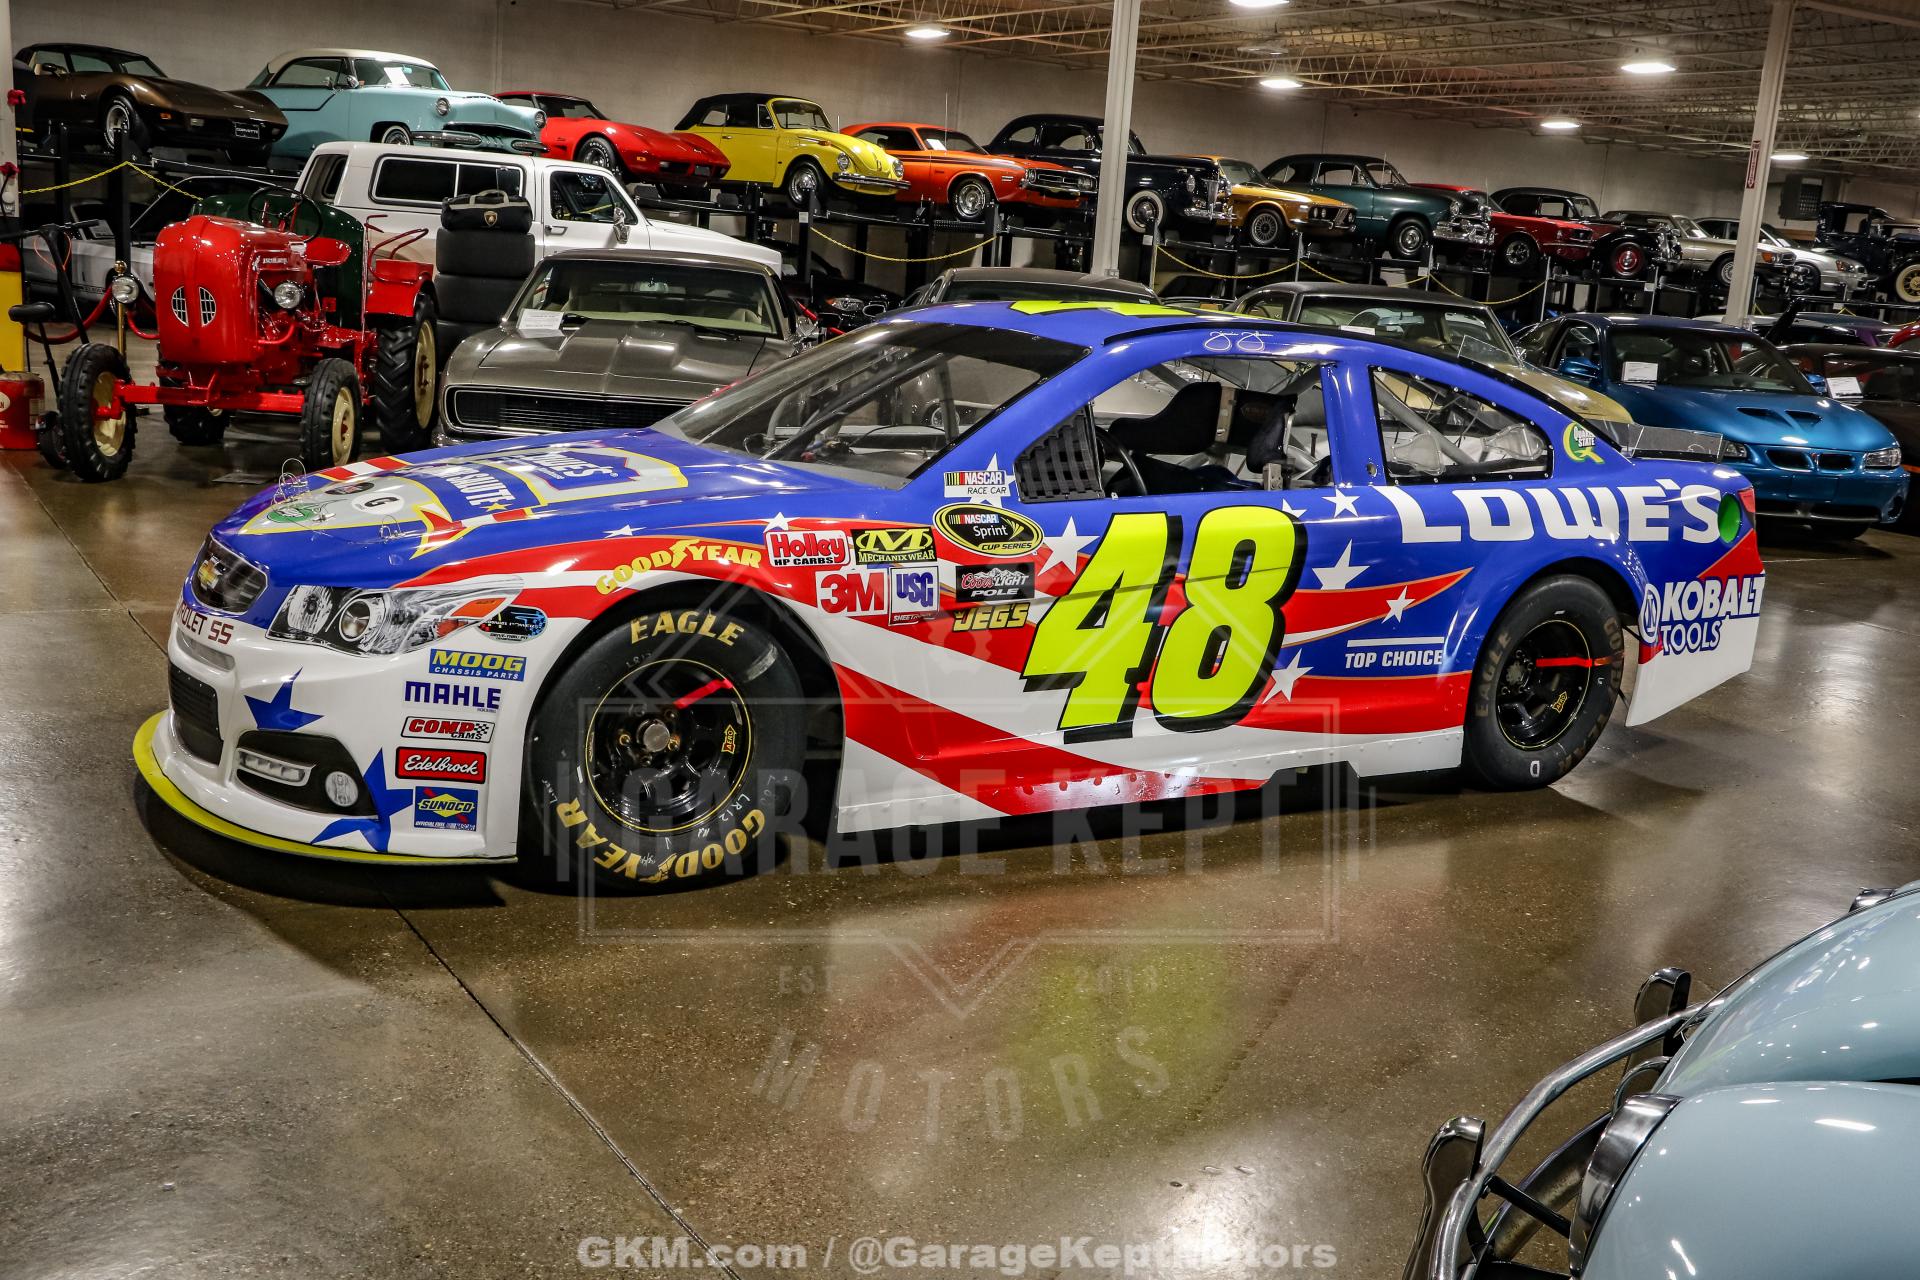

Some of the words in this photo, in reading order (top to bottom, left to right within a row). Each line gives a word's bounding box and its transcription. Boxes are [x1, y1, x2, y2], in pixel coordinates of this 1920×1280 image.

[1578, 437, 1596, 447] STATE
[965, 472, 1002, 485] NASCAR
[990, 486, 1007, 494] CAR
[964, 514, 999, 524] NASCAR
[1369, 479, 1721, 544] LOWE'S
[973, 525, 1009, 539] Sprint
[770, 532, 846, 563] Holley
[1003, 542, 1033, 550] SERIES
[774, 558, 789, 566] HP
[794, 557, 834, 566] CARBS
[858, 551, 907, 563] MECHANIX
[908, 550, 936, 561] WEAR
[595, 539, 762, 595] GOODYEAR
[896, 572, 934, 607] USG
[994, 575, 1029, 588] LIGHT
[820, 572, 885, 614] 3M
[971, 588, 1019, 598] POLE
[1661, 576, 1765, 621] KOBALT
[208, 620, 234, 645] SS
[630, 608, 745, 647] EAGLE
[1019, 505, 1308, 745] 48
[1661, 621, 1721, 653] TOOLS
[432, 651, 525, 672] MOOG
[1345, 652, 1377, 669] TOP
[1381, 649, 1443, 667] CHOICE
[434, 667, 481, 677] CHASSIS
[486, 670, 519, 680] PARTS
[404, 681, 501, 710] MAHLE
[408, 719, 475, 734] COMP
[450, 732, 482, 740] CAMS
[404, 754, 479, 775] Edelbrock
[421, 800, 473, 812] SUNOCO
[556, 796, 766, 883] GOODYEAR
